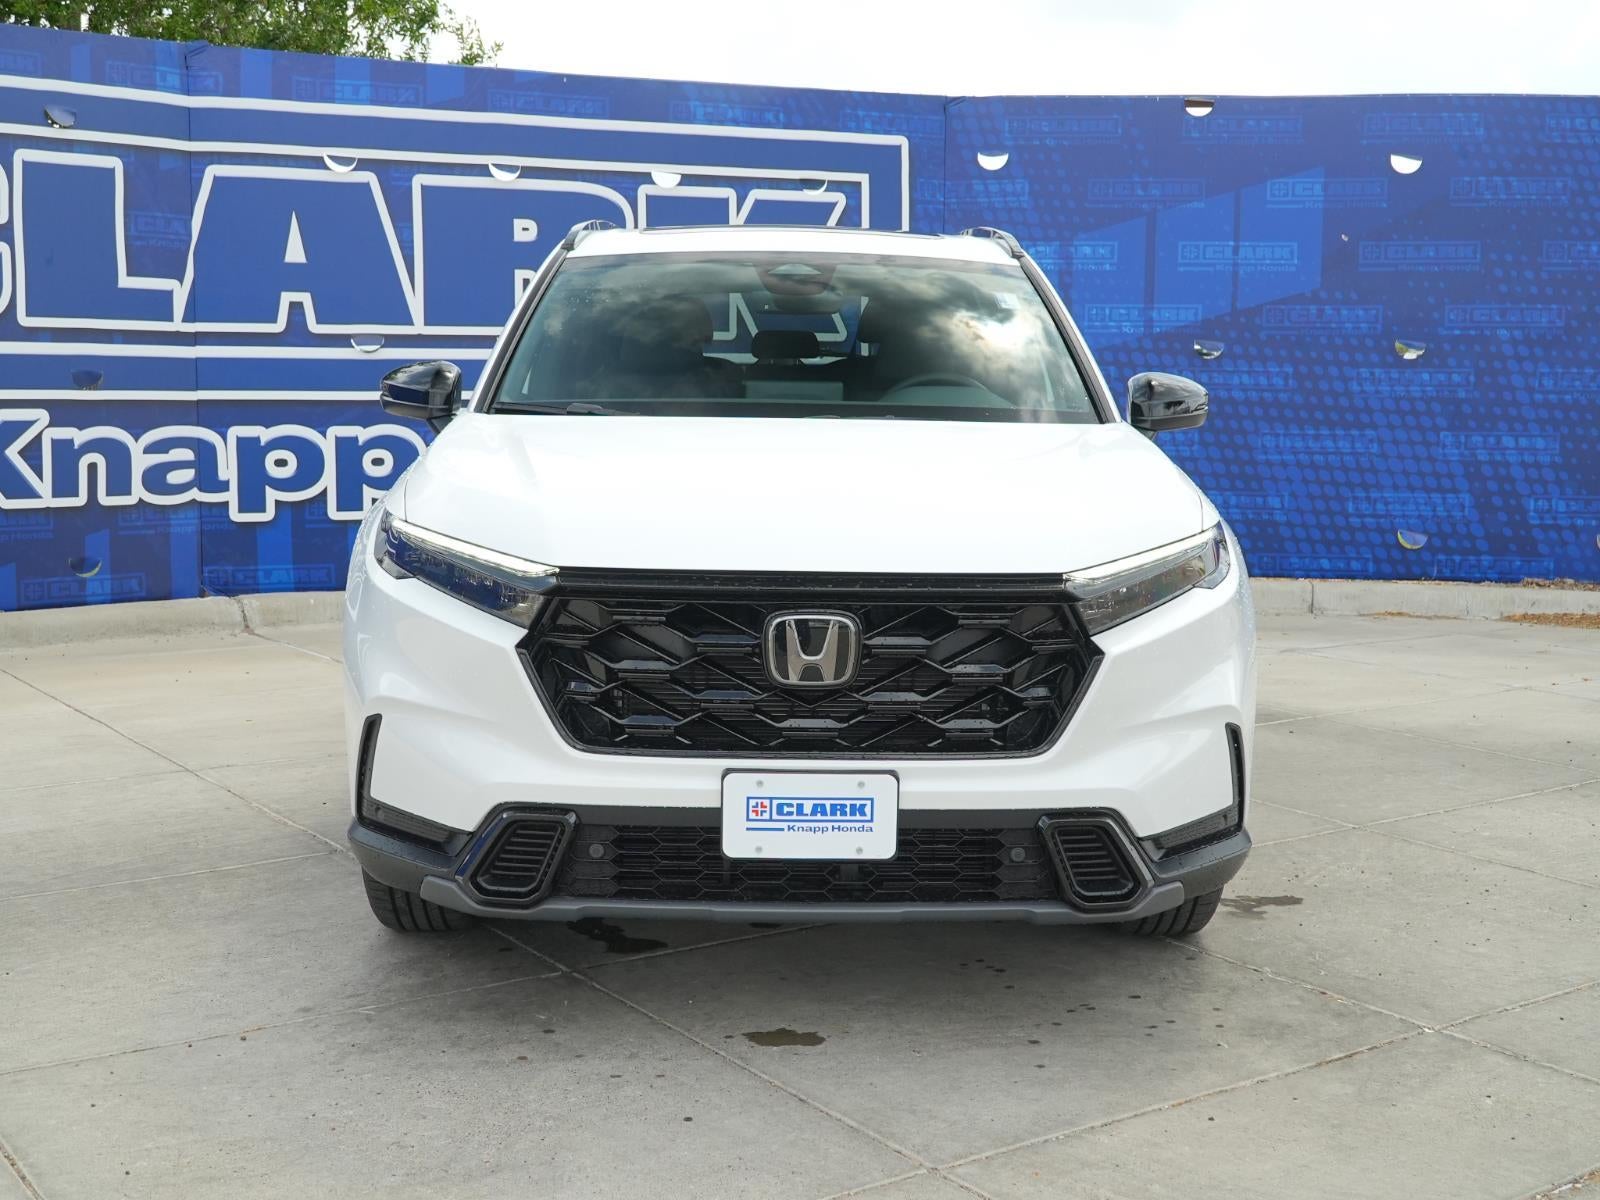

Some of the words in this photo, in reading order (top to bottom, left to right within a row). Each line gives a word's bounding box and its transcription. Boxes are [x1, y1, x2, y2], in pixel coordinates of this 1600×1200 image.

[1205, 246, 1292, 259] CLARK
[776, 802, 868, 817] CLARK
[787, 824, 829, 834] Knapp
[831, 824, 873, 832] Honda
